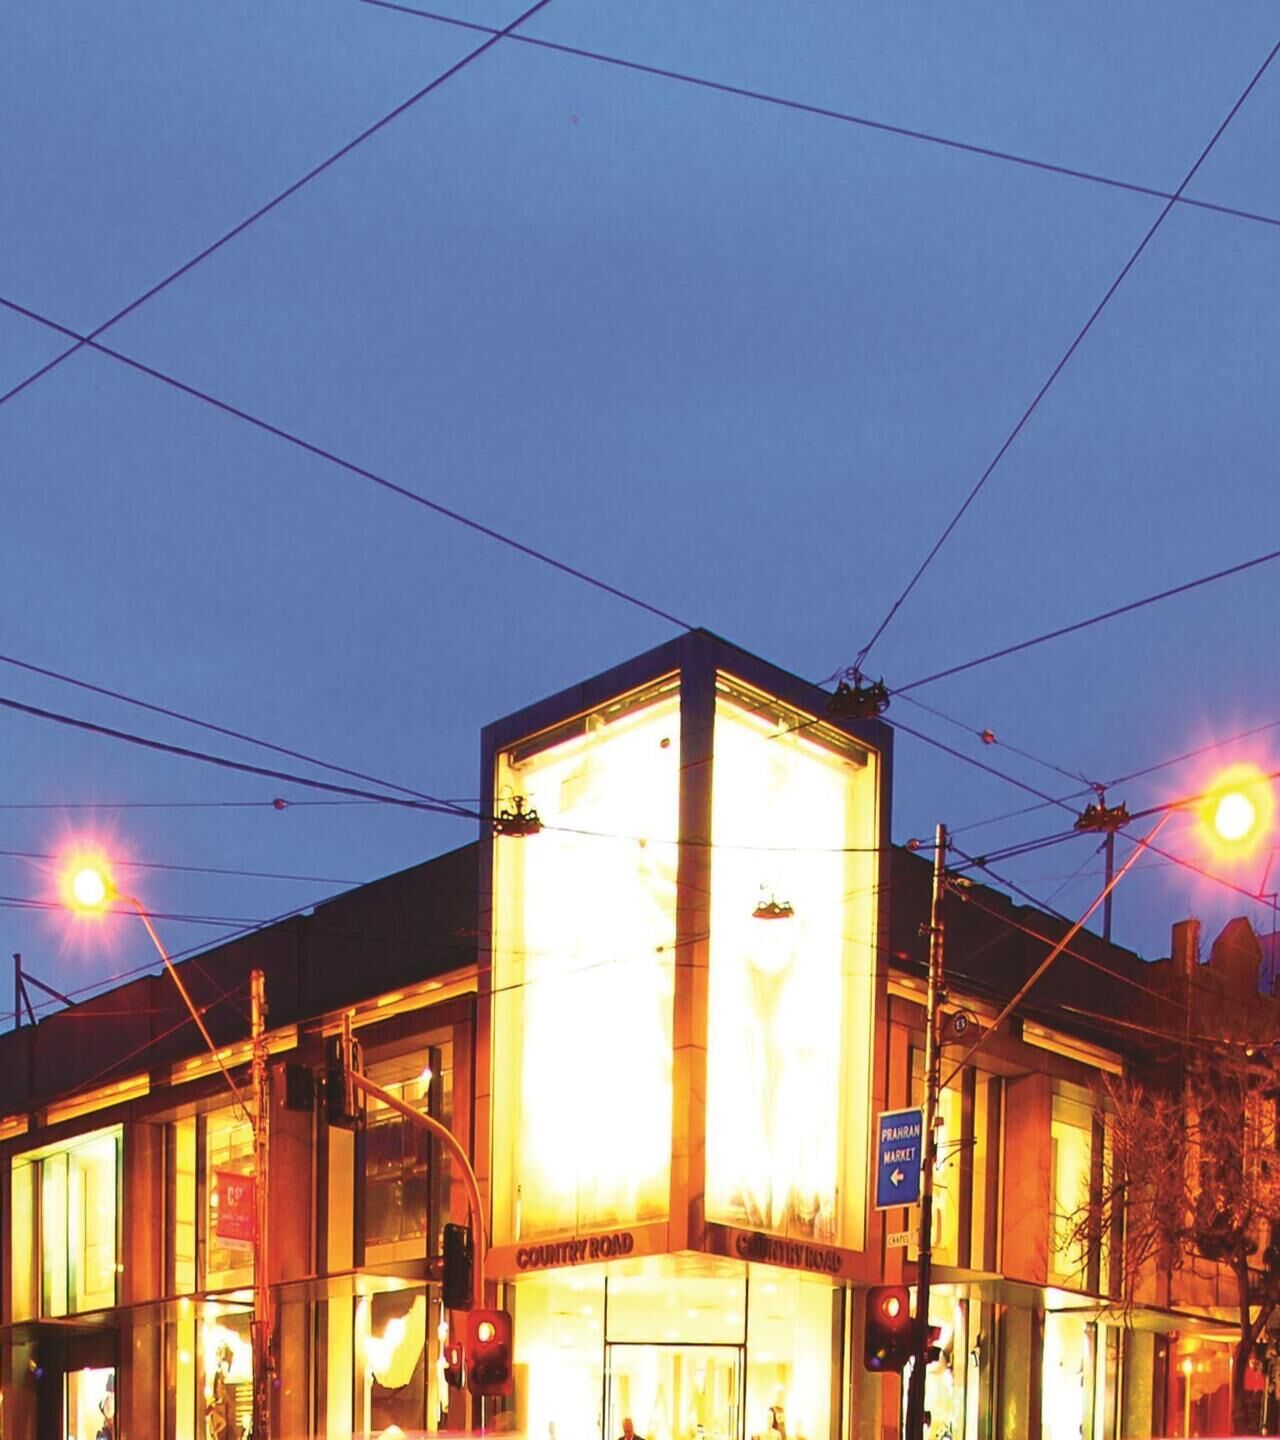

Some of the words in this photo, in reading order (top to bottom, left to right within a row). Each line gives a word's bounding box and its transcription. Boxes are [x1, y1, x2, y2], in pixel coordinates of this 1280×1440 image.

[881, 1124, 920, 1143] PRAHRAN
[883, 1147, 916, 1165] MARKET
[516, 1239, 588, 1270] COUNTRY
[588, 1232, 634, 1259] ROAD
[735, 1231, 803, 1267] CNTRY
[804, 1245, 842, 1273] ROAD
